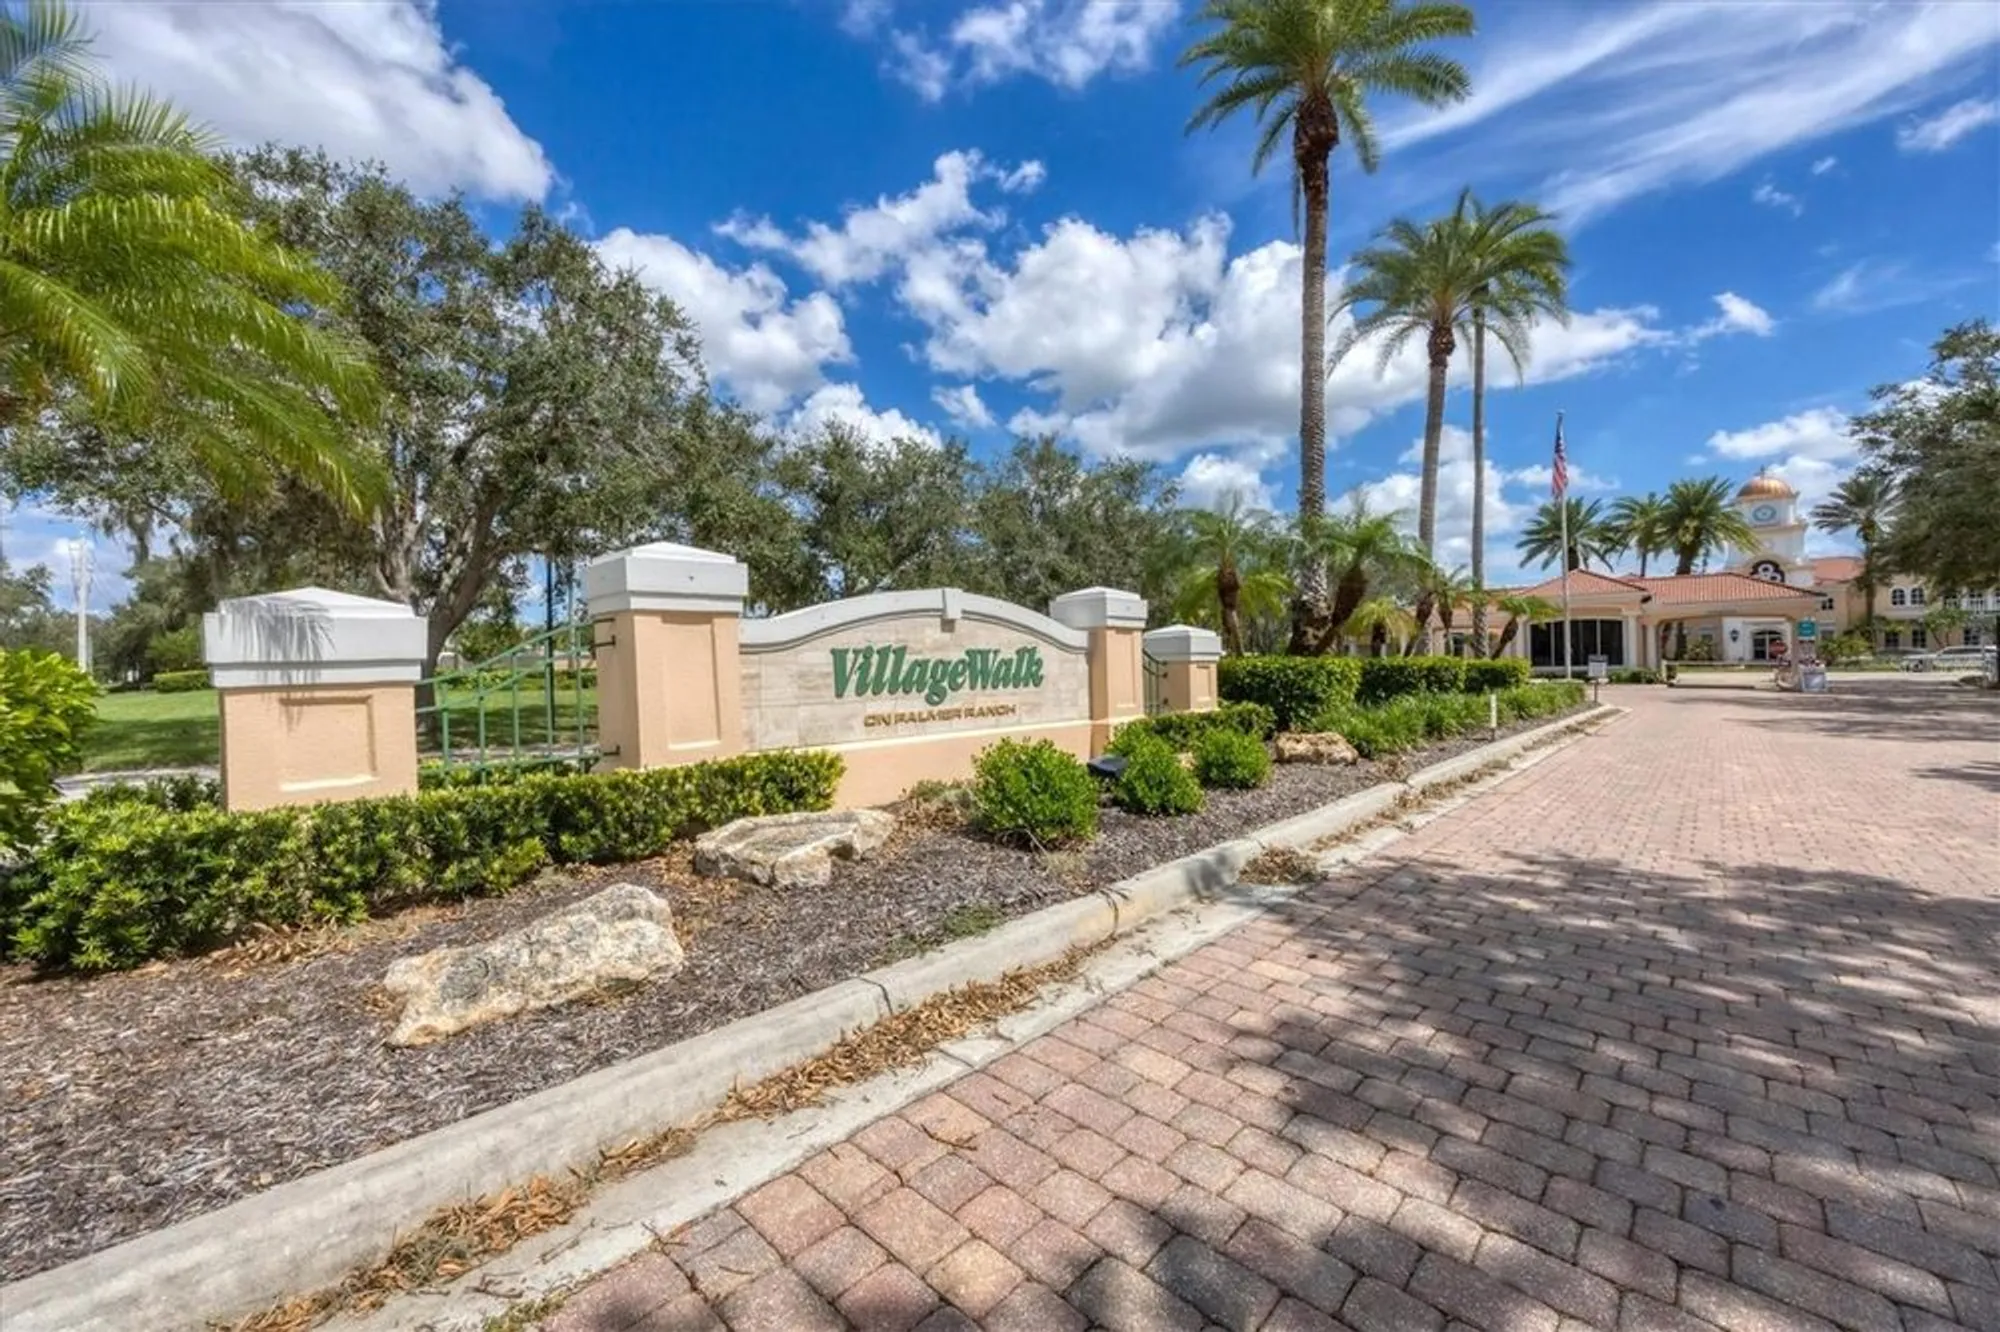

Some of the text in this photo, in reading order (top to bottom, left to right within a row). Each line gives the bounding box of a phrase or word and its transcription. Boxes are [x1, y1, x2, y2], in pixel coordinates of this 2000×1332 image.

[830, 644, 1044, 706] VillageWalk
[863, 704, 1017, 728] ON PALMER RANCH
